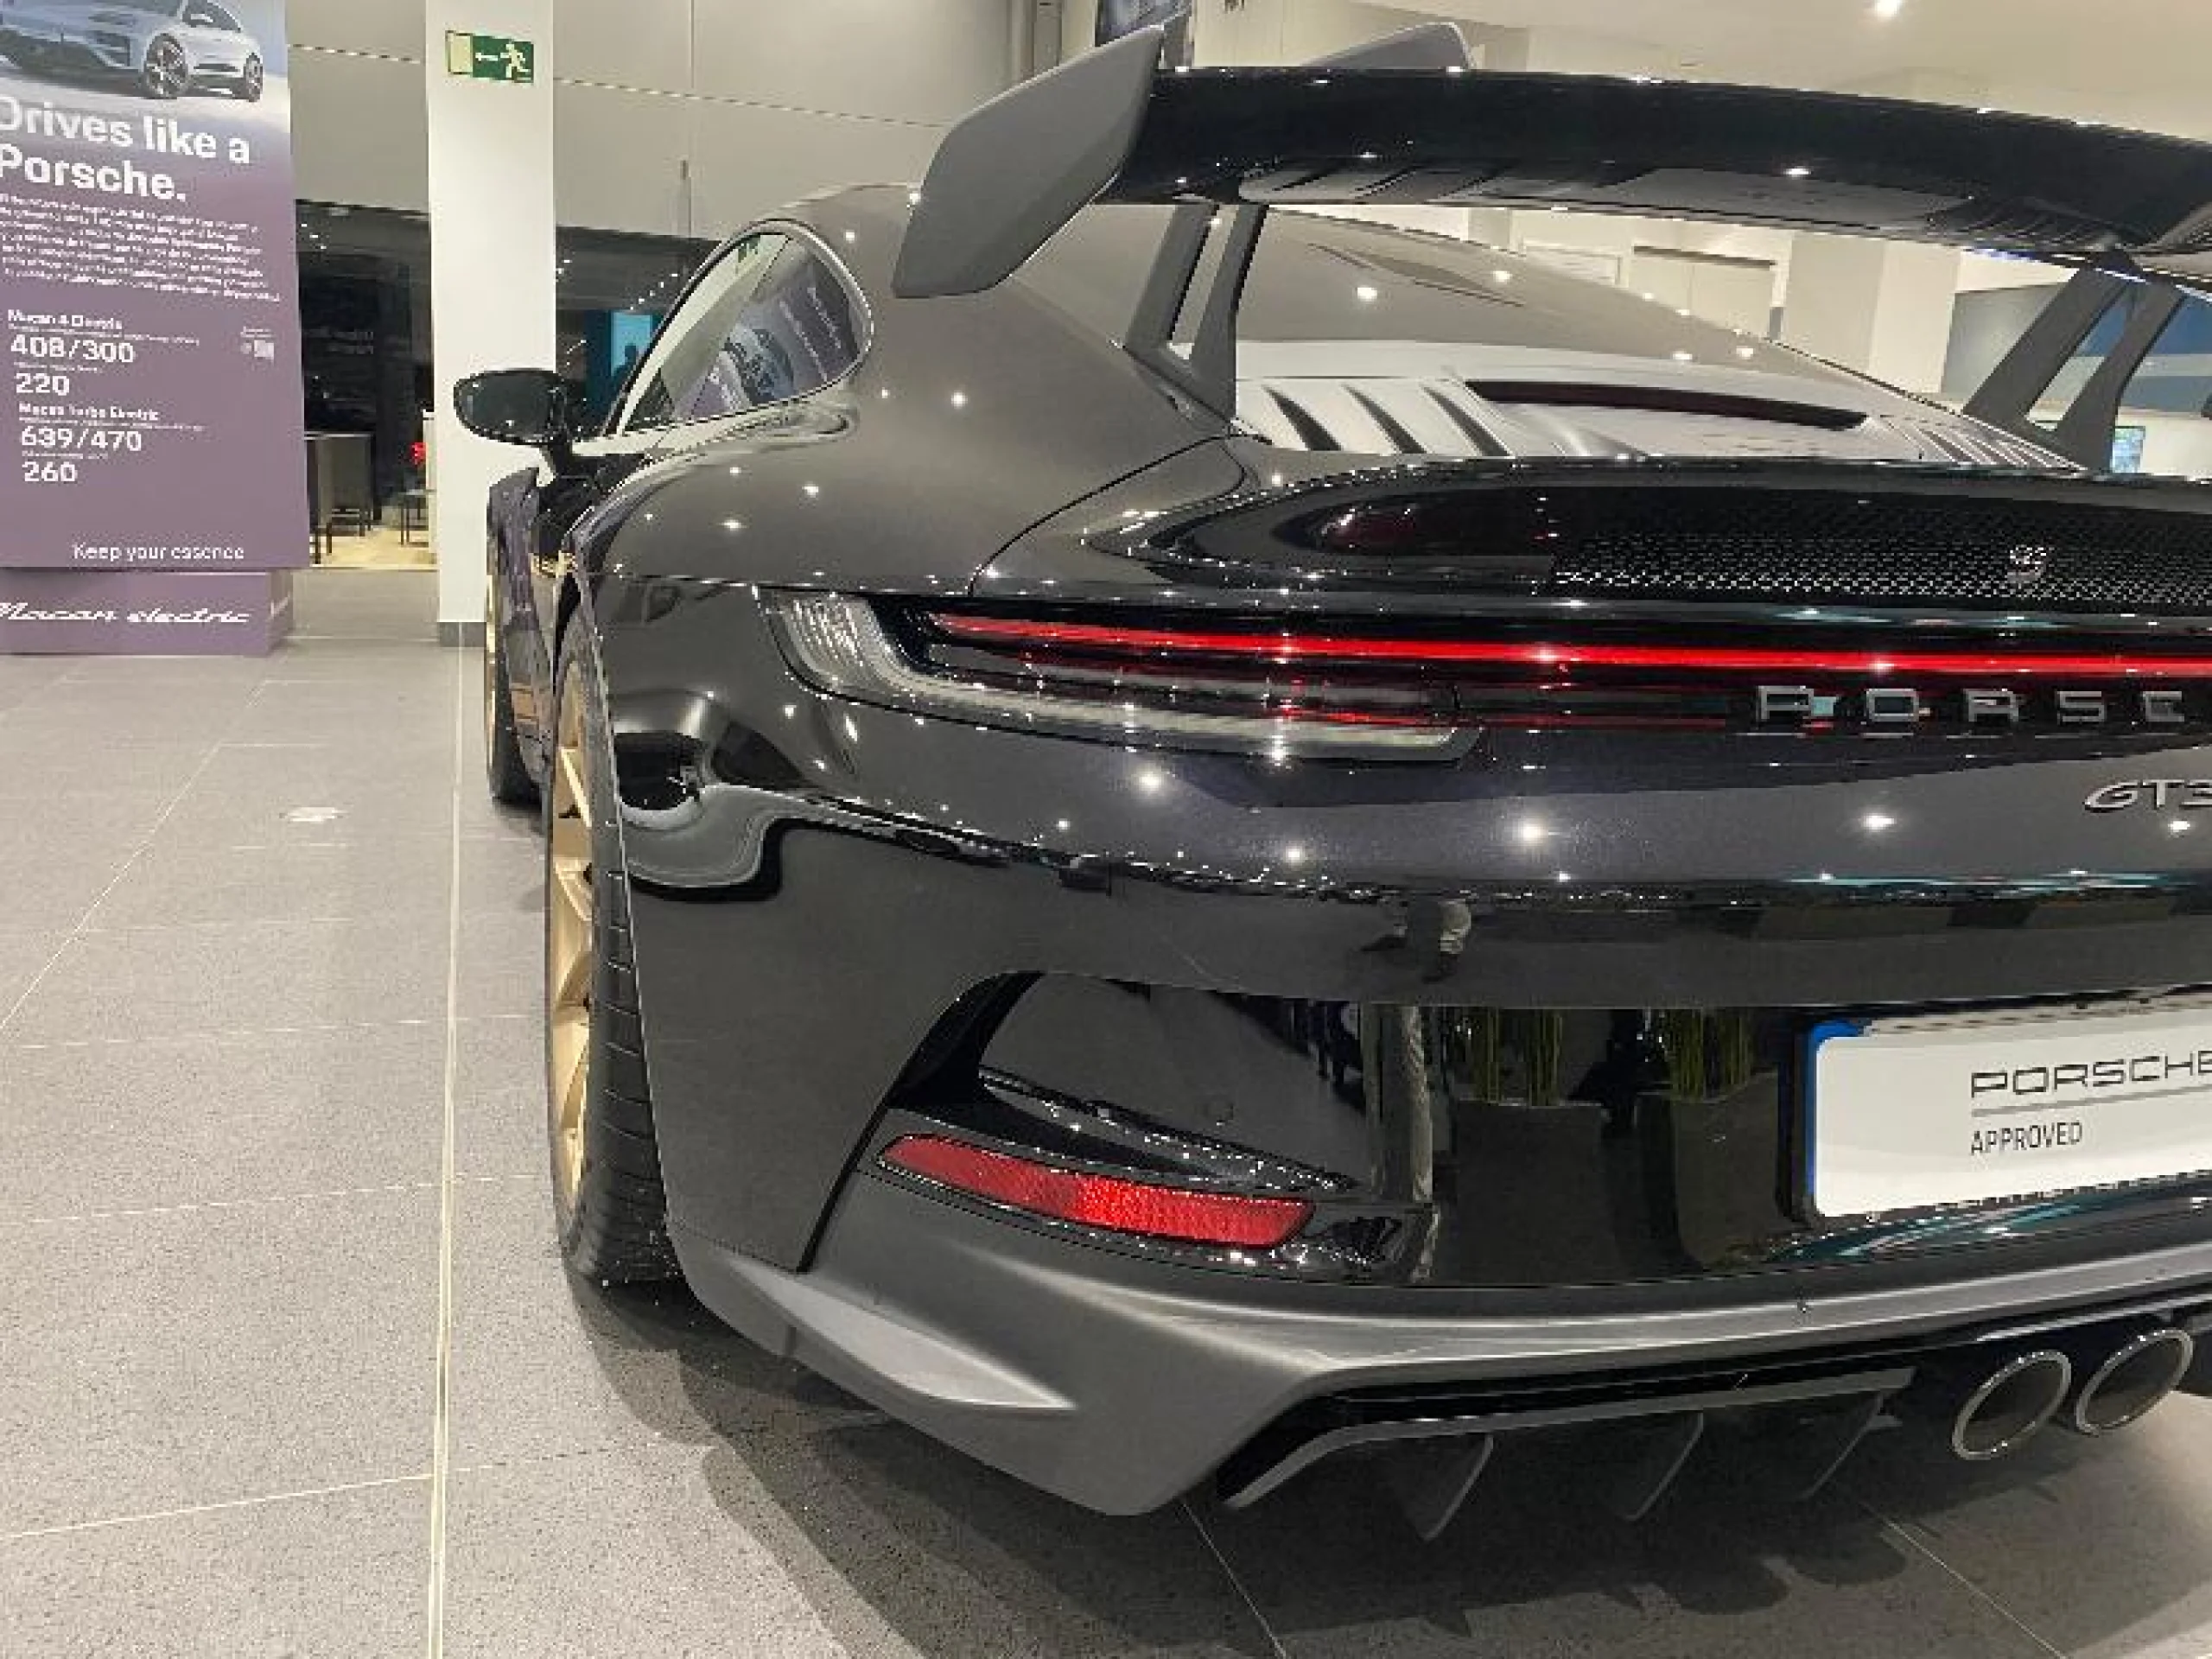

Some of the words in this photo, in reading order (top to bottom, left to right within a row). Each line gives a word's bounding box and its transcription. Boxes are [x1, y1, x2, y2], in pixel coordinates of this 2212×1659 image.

[0, 96, 133, 148] Drives
[143, 115, 217, 159] like
[229, 137, 251, 164] a
[0, 143, 186, 200] Porsche.
[10, 334, 136, 363] 408/300
[16, 372, 70, 397] 220
[21, 425, 142, 452] 639/470
[22, 461, 77, 482] 260
[72, 541, 122, 562] Keep
[126, 545, 166, 562] your
[171, 546, 245, 560] essence
[1971, 1121, 2082, 1156] APPROVED
